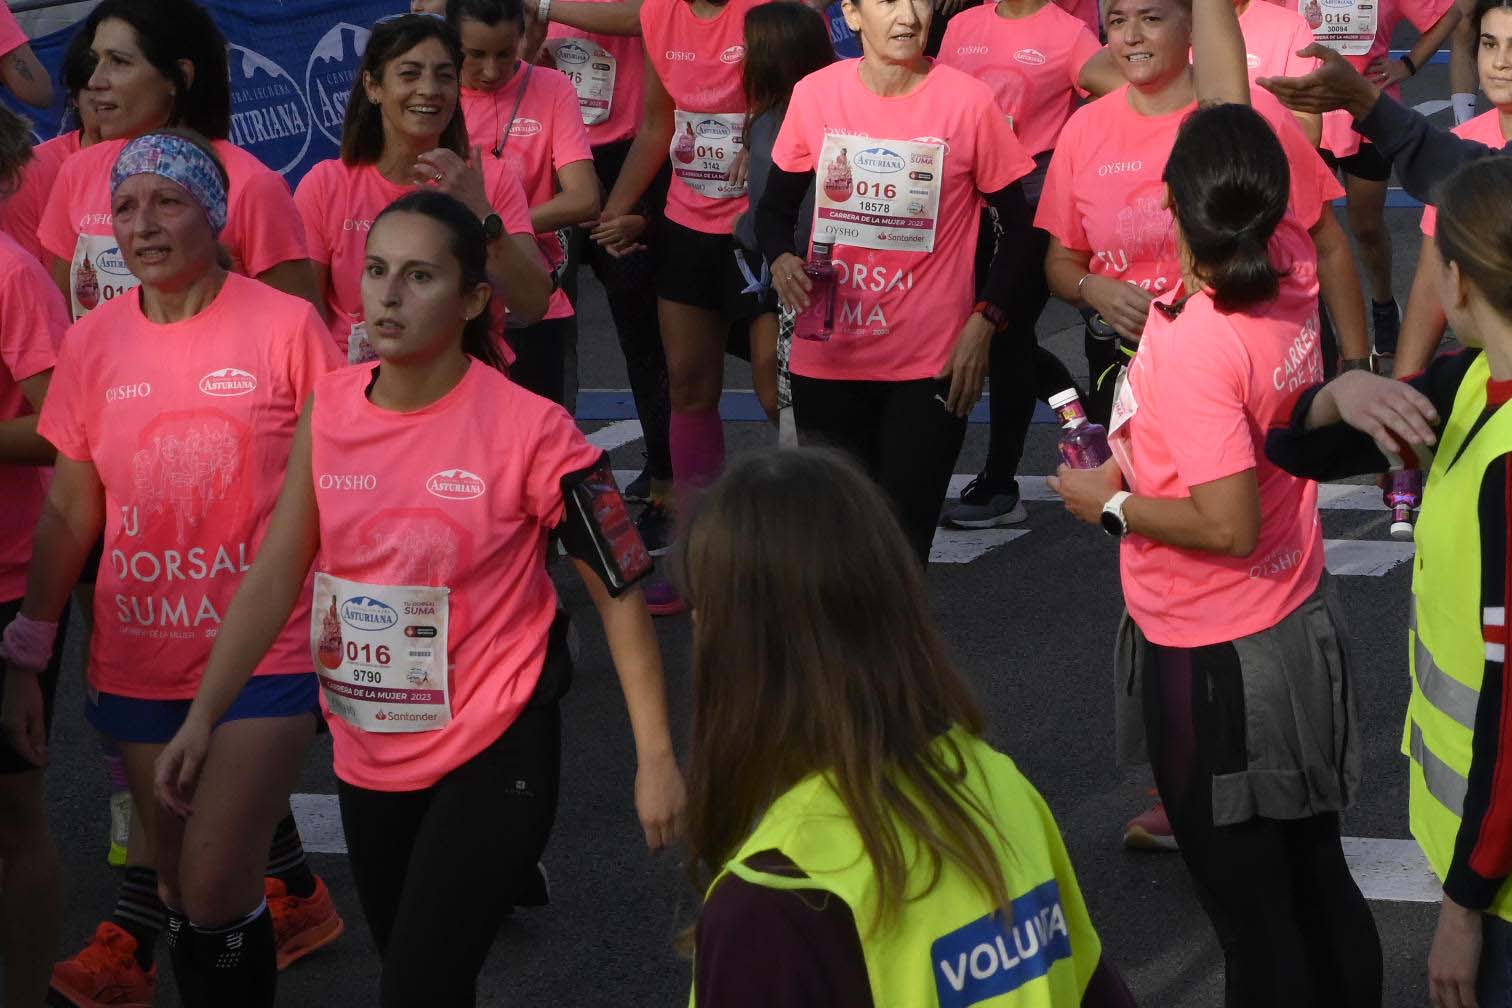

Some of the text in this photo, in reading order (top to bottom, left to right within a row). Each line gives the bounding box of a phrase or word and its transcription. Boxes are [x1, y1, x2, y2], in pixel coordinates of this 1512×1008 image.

[1325, 13, 1351, 23] 016
[957, 44, 989, 56] OYSHO
[231, 101, 307, 146] TURIANA
[696, 145, 724, 160] 016
[703, 161, 720, 170] 3142
[856, 157, 901, 170] ASTURIANA
[910, 157, 933, 166] SUMA
[1098, 160, 1142, 176] OYSHO
[856, 180, 897, 199] 016
[859, 200, 890, 213] 18578
[829, 211, 860, 222] CARRERA
[861, 215, 871, 223] DE
[871, 216, 880, 224] LA
[881, 218, 906, 226] MUJER
[825, 225, 859, 238] OYSHO
[887, 233, 925, 243] Santander
[102, 284, 133, 301] 01
[839, 298, 887, 327] MA
[204, 378, 254, 391] ASTURIANA
[319, 473, 377, 490] OYSHO
[431, 478, 482, 494] ASTURIANA
[111, 542, 250, 582] DORSAL
[114, 593, 221, 627] SUMA
[344, 606, 393, 625] ASTURIANA
[404, 606, 436, 616] SUMA
[346, 641, 392, 665] 016
[353, 669, 382, 684] 9790
[354, 687, 364, 697] DE
[365, 688, 376, 698] LA
[377, 690, 408, 700] MUJER
[411, 692, 432, 701] 2023
[388, 710, 438, 722] Santander
